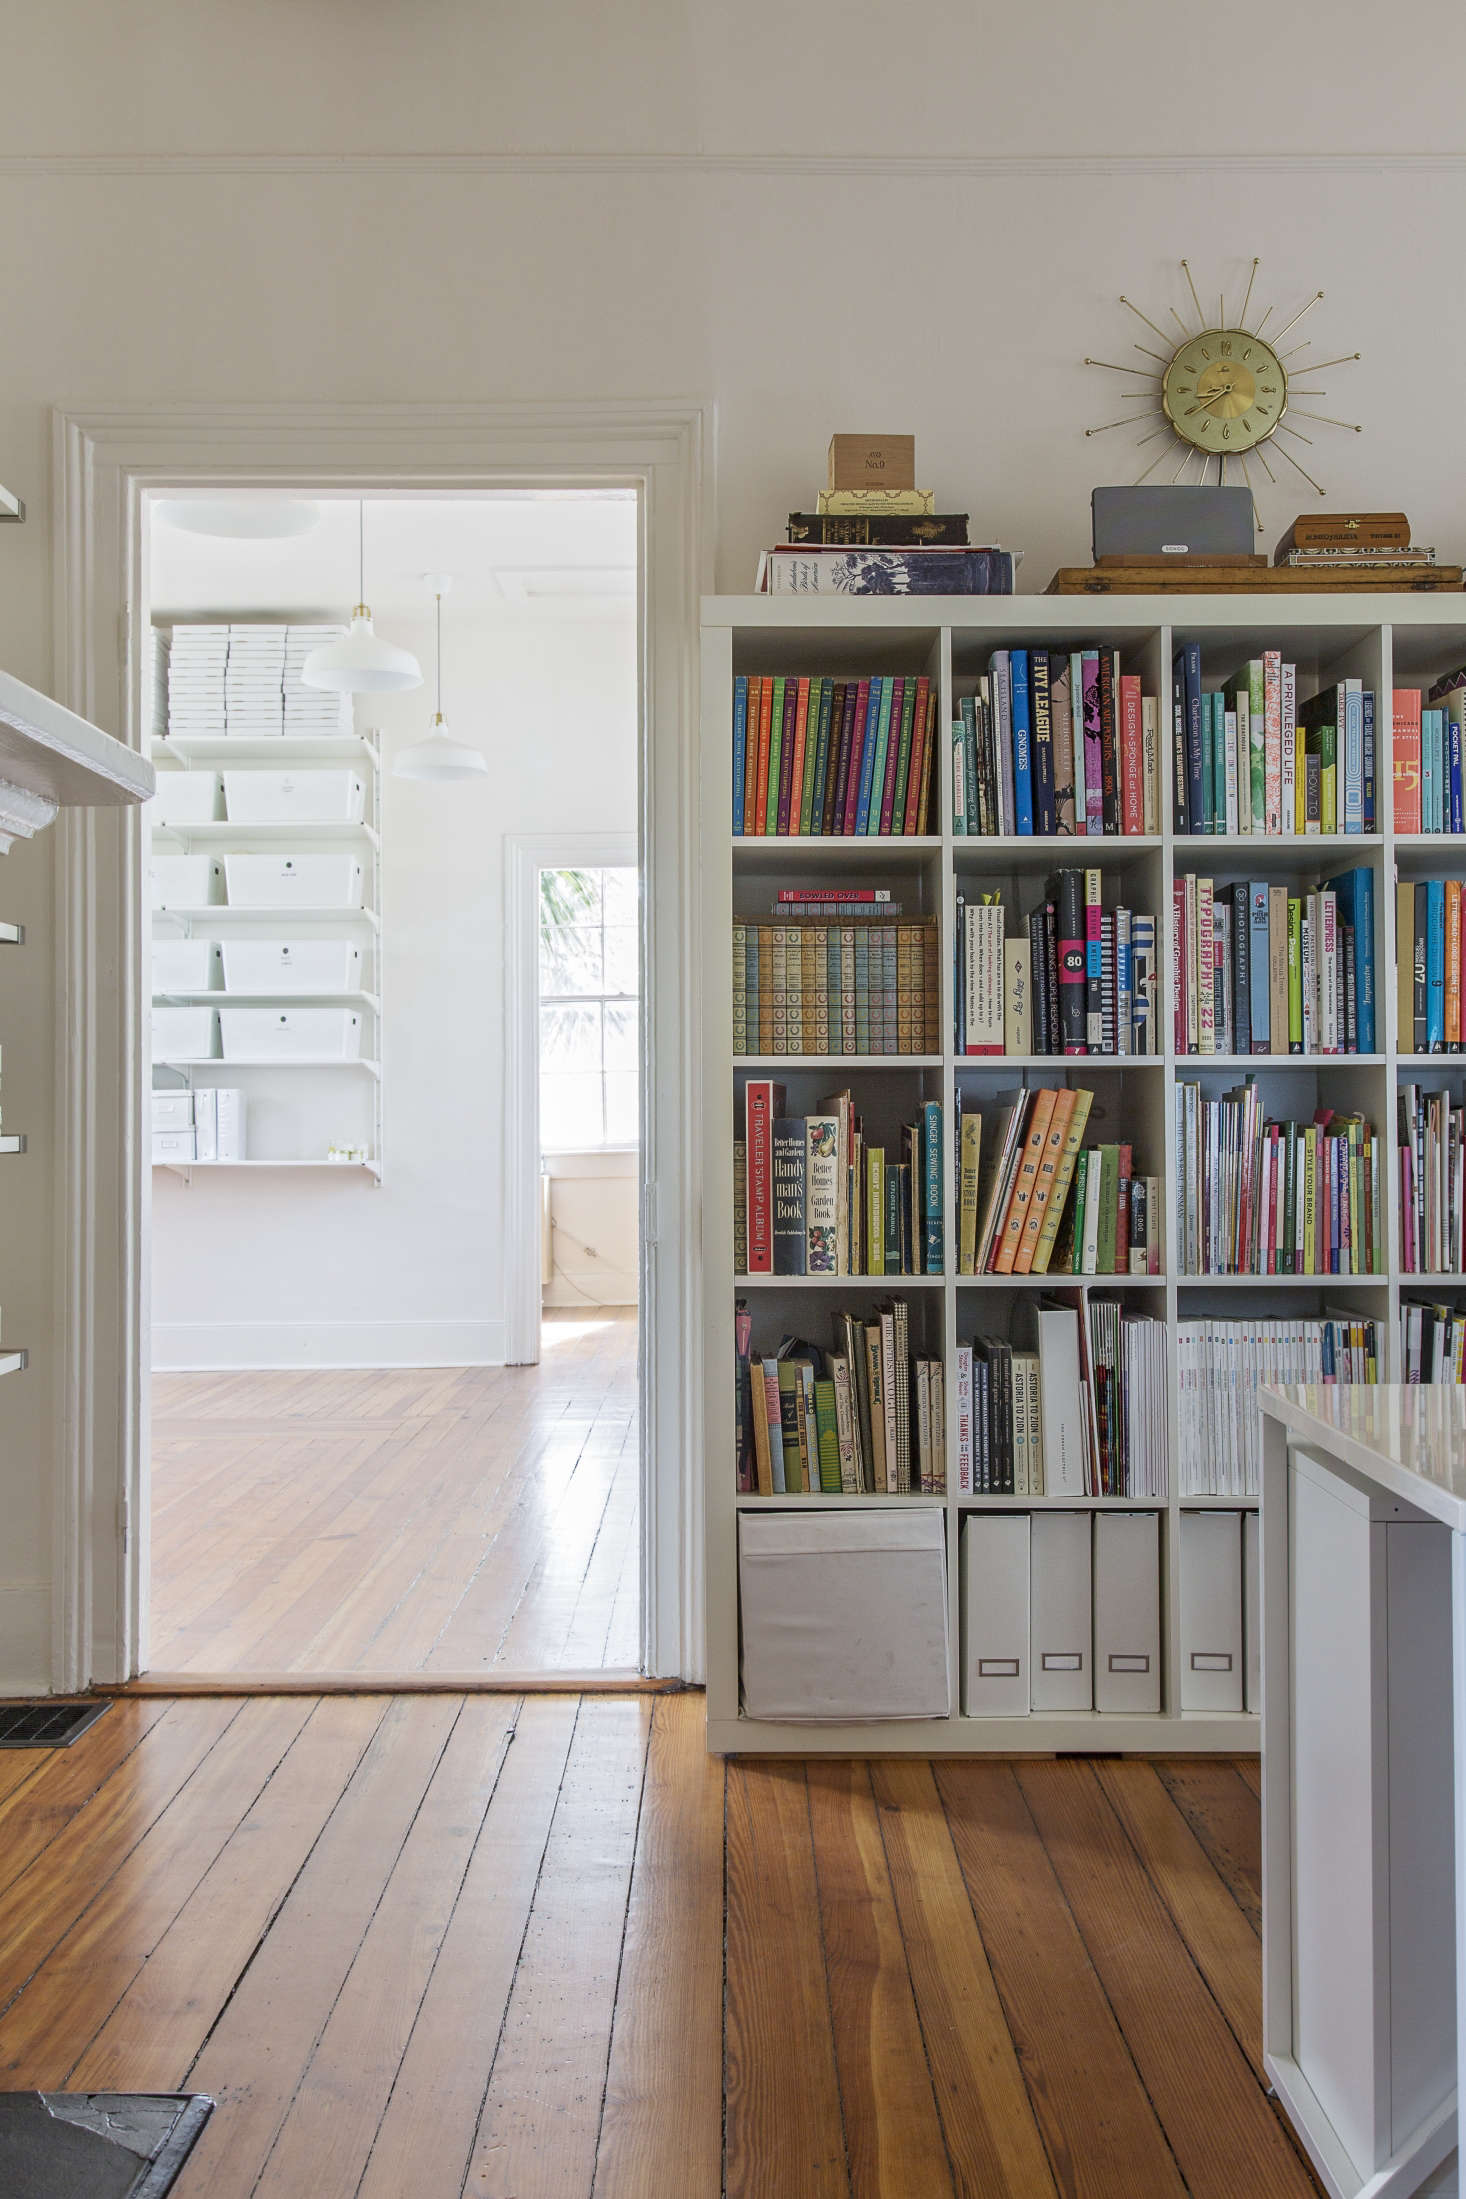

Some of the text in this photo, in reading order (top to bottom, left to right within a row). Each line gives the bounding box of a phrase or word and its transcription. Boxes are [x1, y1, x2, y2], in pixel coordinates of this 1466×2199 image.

[1222, 340, 1232, 356] 12
[1102, 656, 1110, 704] AMERICAN
[1034, 666, 1049, 742] IVY LEAGUE
[1192, 698, 1201, 738] Charleston
[1284, 671, 1293, 784] A PRIVILEGED LIFE
[966, 736, 974, 768] Preservation
[1017, 730, 1027, 770] GNOMES
[1146, 728, 1154, 774] ReadyMade
[1190, 748, 1200, 760] My
[1129, 792, 1138, 818] HOME
[1308, 768, 1318, 816] HOW TO
[1325, 901, 1334, 952] LETTERPRESS
[1067, 956, 1081, 966] 80
[1200, 886, 1212, 1029] TYPOGRAPHY 22
[1090, 980, 1098, 991] TWO
[1050, 1003, 1058, 1044] RESPOND
[775, 1159, 805, 1178] Handy
[813, 1163, 832, 1173] Better
[929, 1115, 938, 1207] SINGER SEWING BOOK
[776, 1180, 803, 1198] man's
[812, 1176, 832, 1185] Homes
[777, 1201, 802, 1219] Book
[811, 1197, 833, 1206] Garden
[814, 1209, 831, 1218] Book
[756, 1205, 764, 1240] ALBUM
[887, 1380, 895, 1423] VOGUE
[1029, 1372, 1038, 1402] ASTORIA
[1030, 1405, 1038, 1413] TO
[960, 1414, 968, 1442] THANKS
[960, 1454, 968, 1489] FEEDBACK
